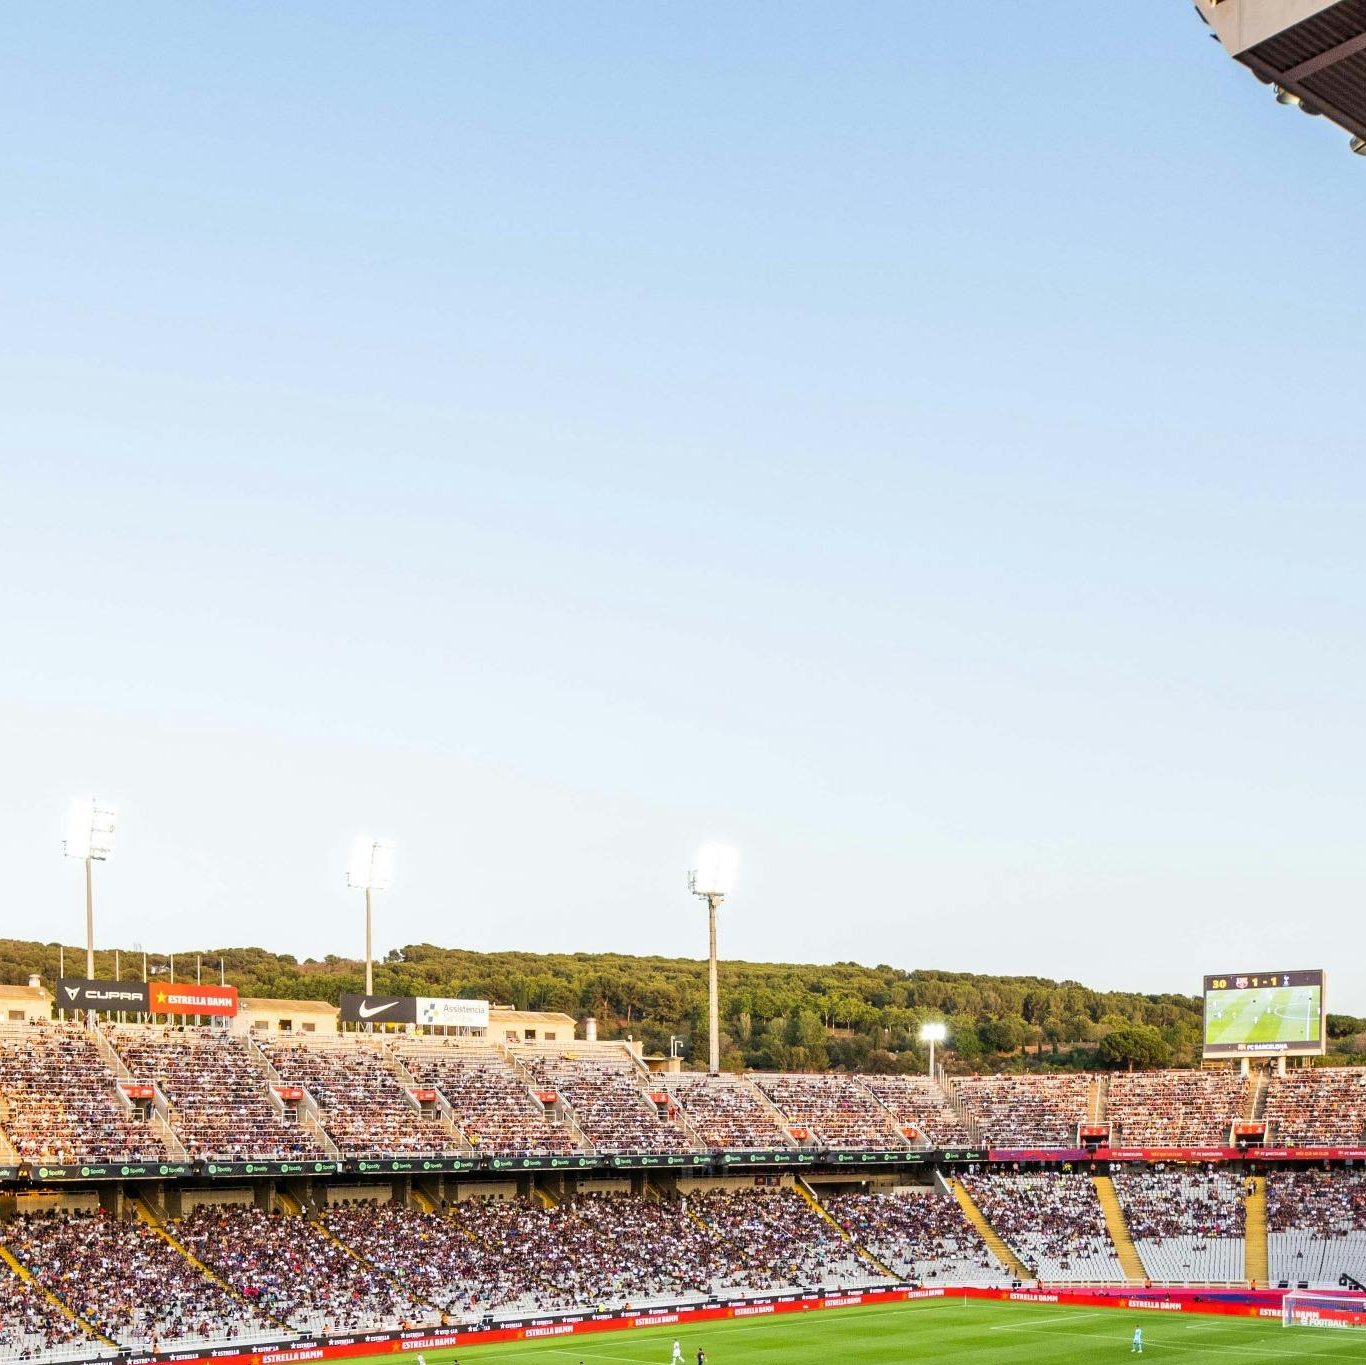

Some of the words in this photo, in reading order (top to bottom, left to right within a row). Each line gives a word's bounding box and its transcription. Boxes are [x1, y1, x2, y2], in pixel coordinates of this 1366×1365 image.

[1212, 979, 1227, 989] 30
[1252, 978, 1258, 987] 1
[1271, 977, 1277, 986] 1
[85, 990, 143, 1001] CUPRA
[168, 995, 204, 1005] ESTRELLA
[206, 997, 233, 1007] DAMM
[48, 1169, 66, 1178] Spotify
[89, 1167, 107, 1176] Spotify
[130, 1167, 146, 1175] Spotify
[908, 1290, 927, 1298] ESTRELLA
[928, 1288, 944, 1296] DAMM
[1010, 1293, 1037, 1301] ESTRELLA
[1038, 1295, 1058, 1303] DAMM
[825, 1299, 845, 1307] ESTRELLA
[846, 1297, 862, 1305] DAMM
[1129, 1300, 1160, 1309] ESTRELLA
[1161, 1301, 1182, 1310] DAMM
[735, 1307, 757, 1316] ESTRELLA
[757, 1305, 774, 1313] DAMM
[635, 1318, 659, 1326] ESTRELLA
[660, 1315, 679, 1323] DAMM
[526, 1327, 554, 1337] ESTRELLA
[555, 1325, 573, 1334] DAMM
[296, 1341, 317, 1349] ESTRELLA
[402, 1340, 433, 1350] ESTRELLA
[435, 1337, 456, 1346] DAMM
[176, 1353, 199, 1361] ESTRELLA
[217, 1349, 240, 1357] ESTRELLA
[263, 1353, 299, 1364] ESTRELLA
[300, 1350, 324, 1360] DAMM
